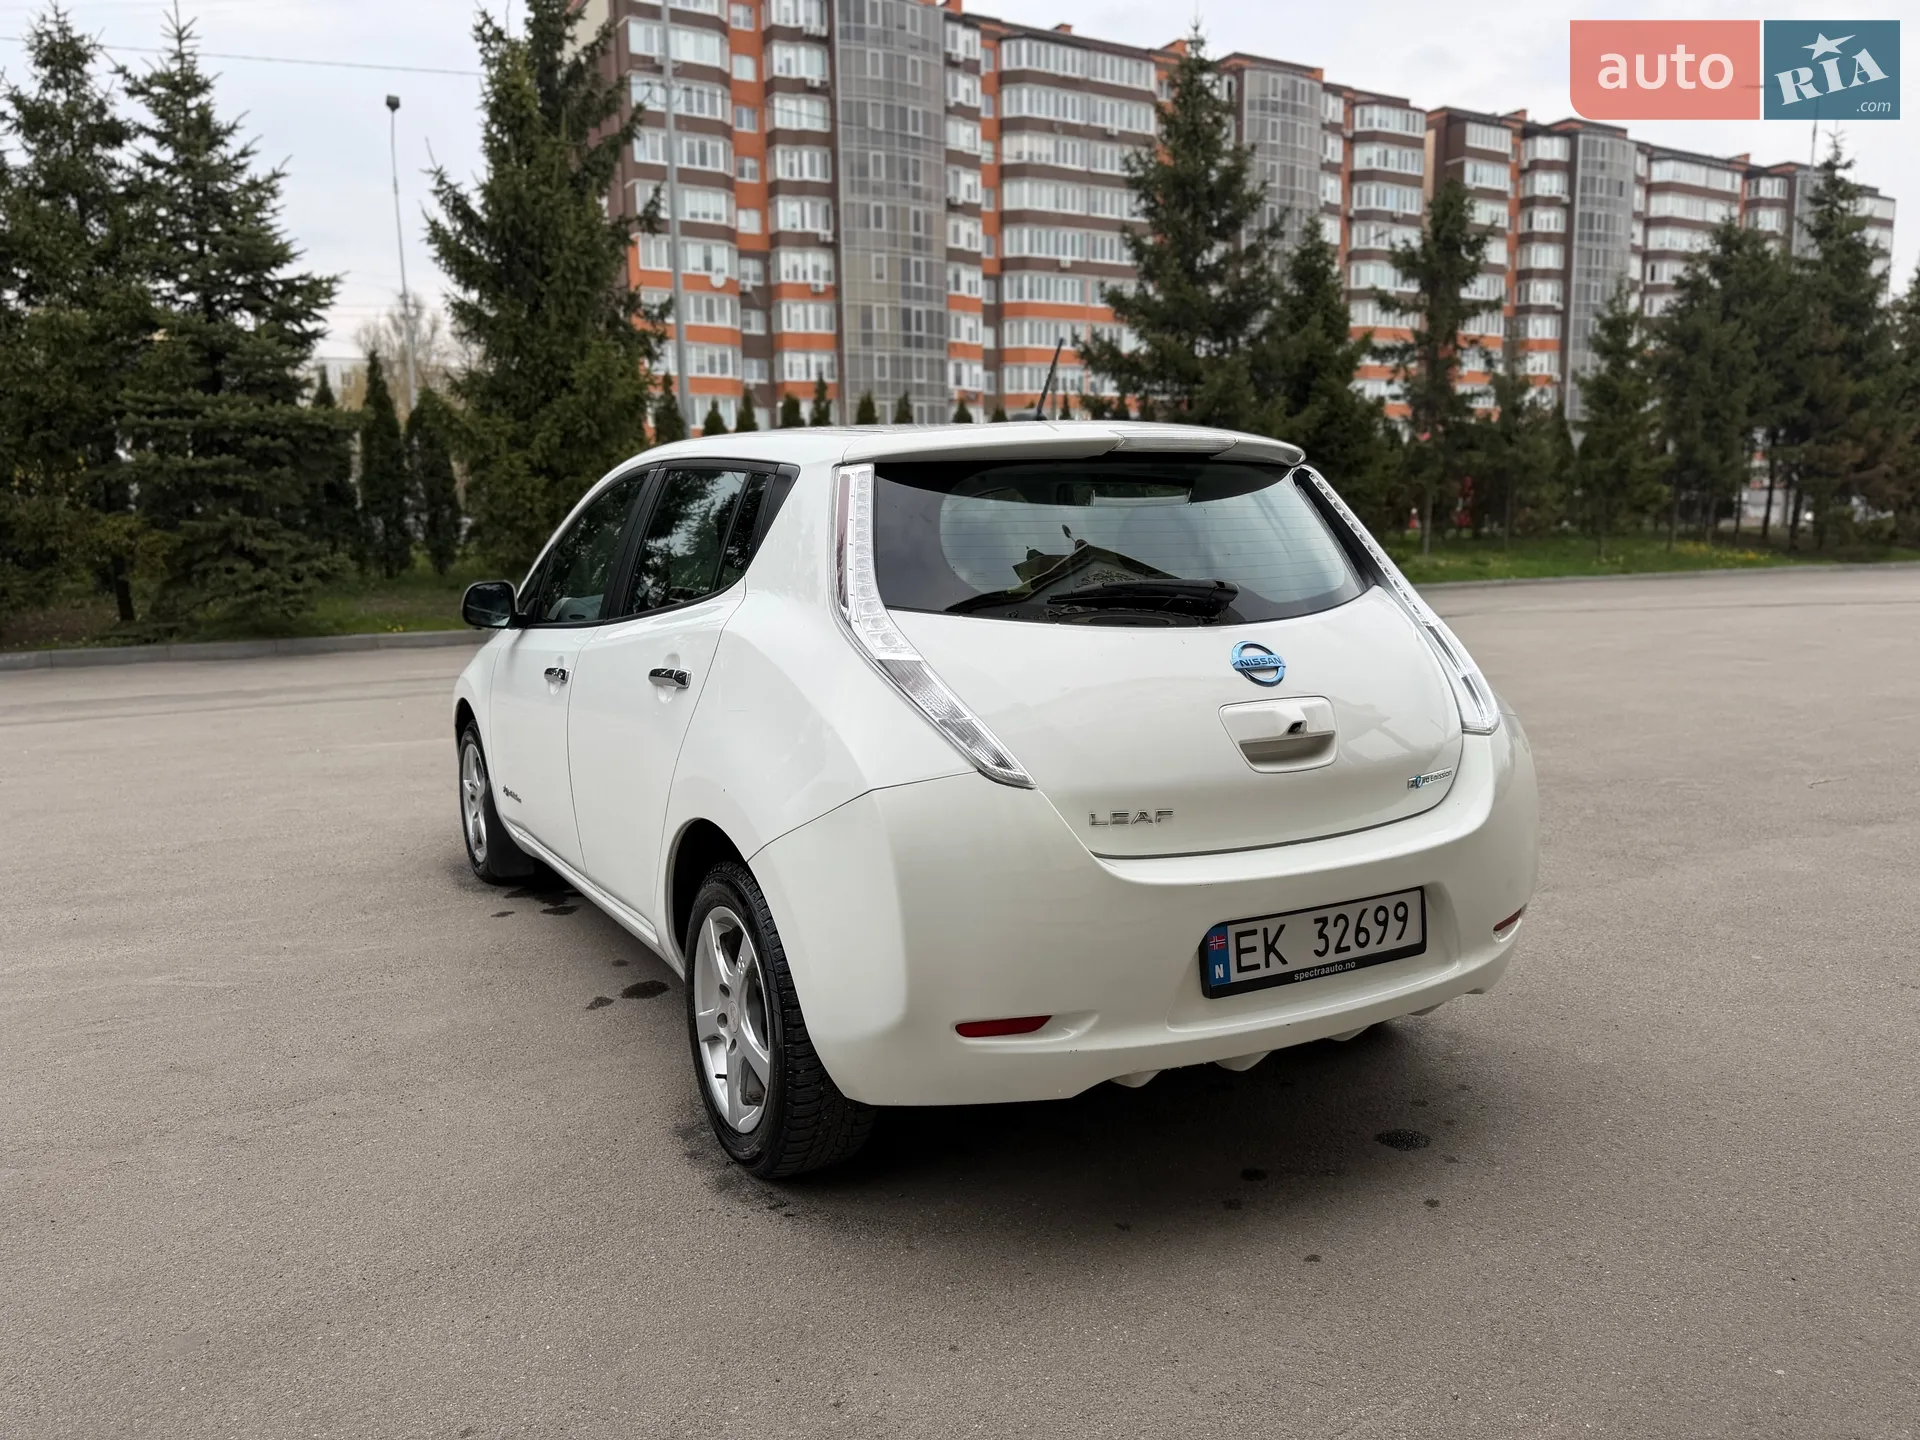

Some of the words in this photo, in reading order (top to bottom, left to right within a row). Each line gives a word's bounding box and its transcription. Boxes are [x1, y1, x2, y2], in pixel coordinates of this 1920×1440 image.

[1239, 657, 1283, 668] NISSAN
[1089, 809, 1174, 827] LEAF
[1235, 924, 1288, 973] EK
[1313, 901, 1409, 957] 32699
[1214, 963, 1225, 979] N
[1294, 961, 1356, 981] spectraauto.no
